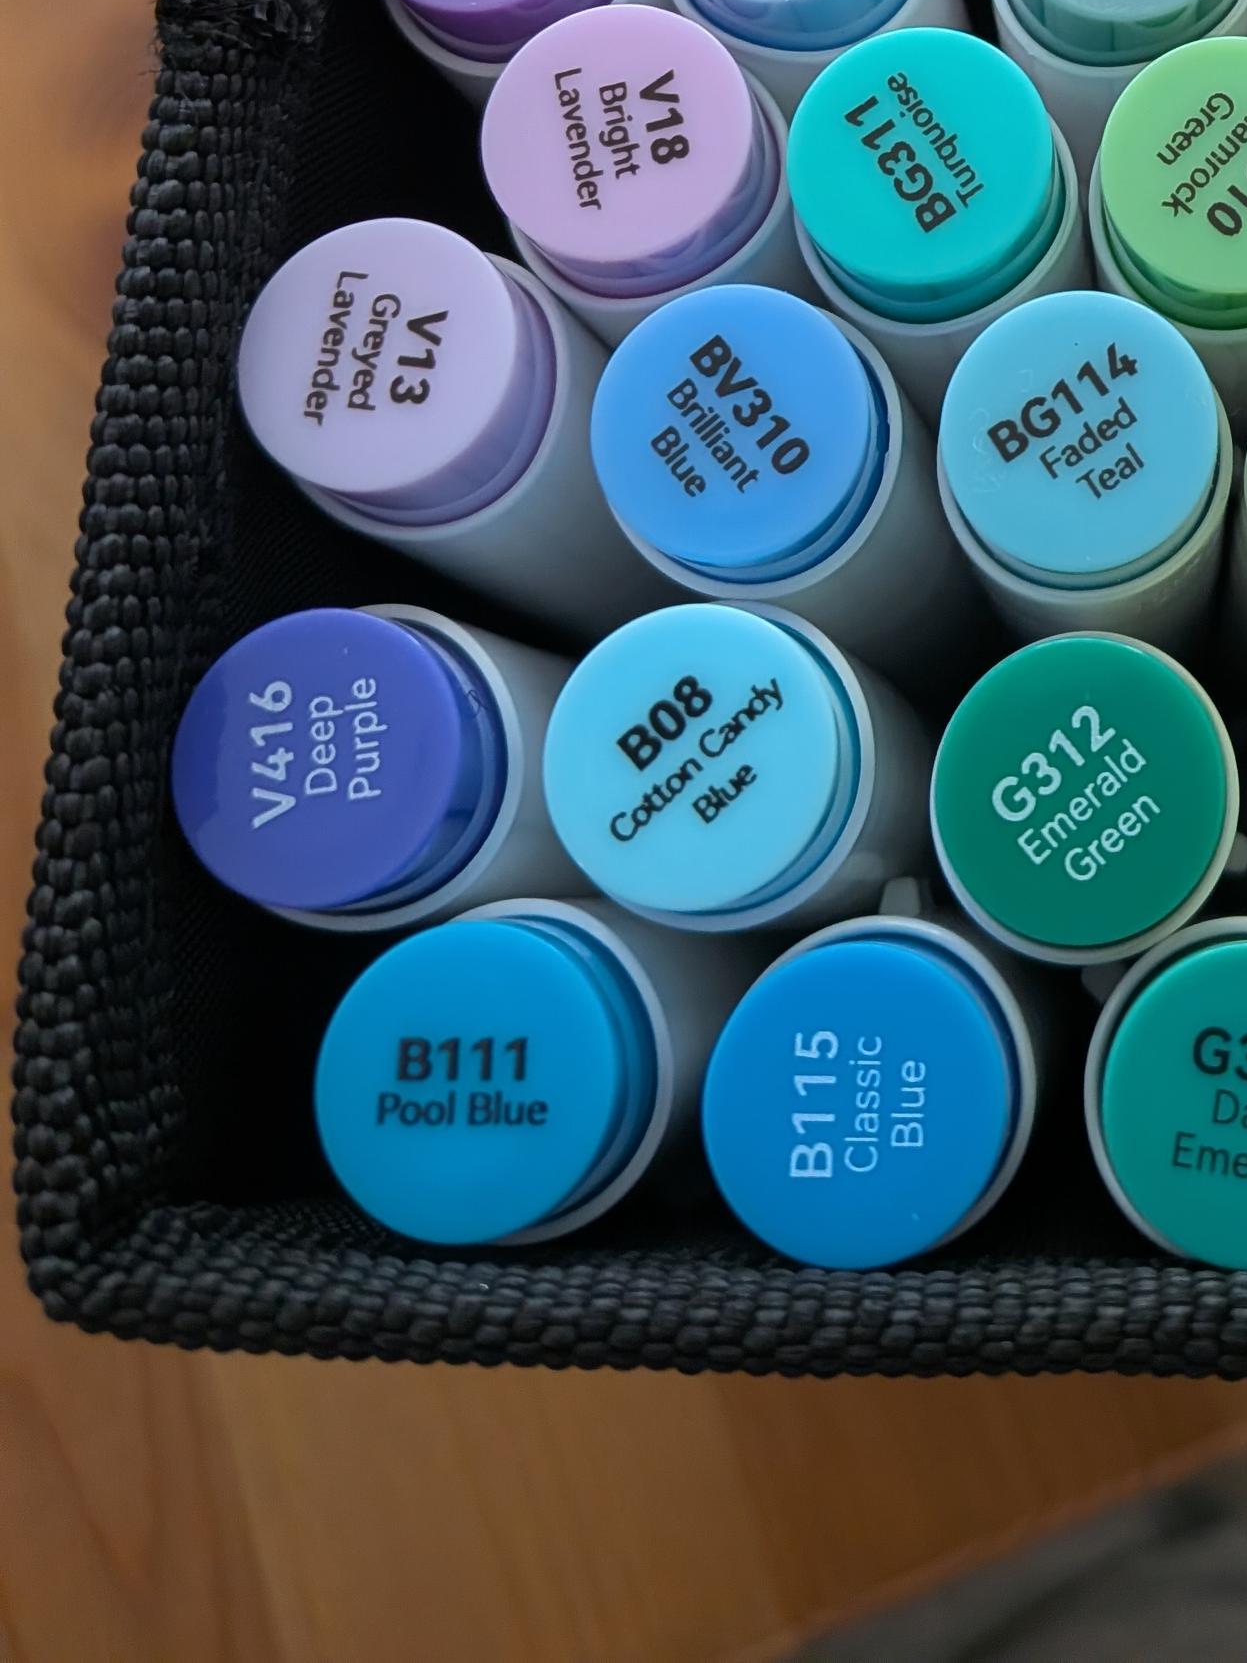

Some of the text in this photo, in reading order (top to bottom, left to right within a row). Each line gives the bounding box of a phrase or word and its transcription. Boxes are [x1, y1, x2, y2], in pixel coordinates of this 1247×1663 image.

[553, 67, 604, 212] Lavender
[599, 81, 641, 180] Bright
[638, 69, 691, 167] V18
[843, 95, 958, 234] BG311
[886, 71, 986, 210] Turquoise
[1156, 91, 1236, 168] Green
[302, 269, 369, 427] Lavender
[347, 292, 401, 413] Greyed
[389, 309, 450, 407] V13
[689, 334, 811, 477] BV310
[986, 341, 1141, 464] BG114
[649, 426, 708, 499] Blue
[665, 377, 763, 496] Brilliant
[1038, 397, 1140, 481] Faded
[1074, 441, 1146, 503] Teal
[249, 679, 297, 831] V416
[304, 694, 345, 797] Deep
[347, 676, 388, 803] Purple
[609, 676, 786, 844] Cotton Candy
[614, 674, 715, 773] B08
[990, 704, 1117, 824] G312
[690, 760, 759, 826] Blue
[1016, 740, 1148, 867] Emerald
[1063, 793, 1162, 884] Green
[376, 1091, 550, 1128] Pool Blue
[396, 1036, 531, 1084] B111
[789, 1029, 839, 1179] B115
[844, 1034, 884, 1175] Classic
[890, 1058, 927, 1149] Blue
